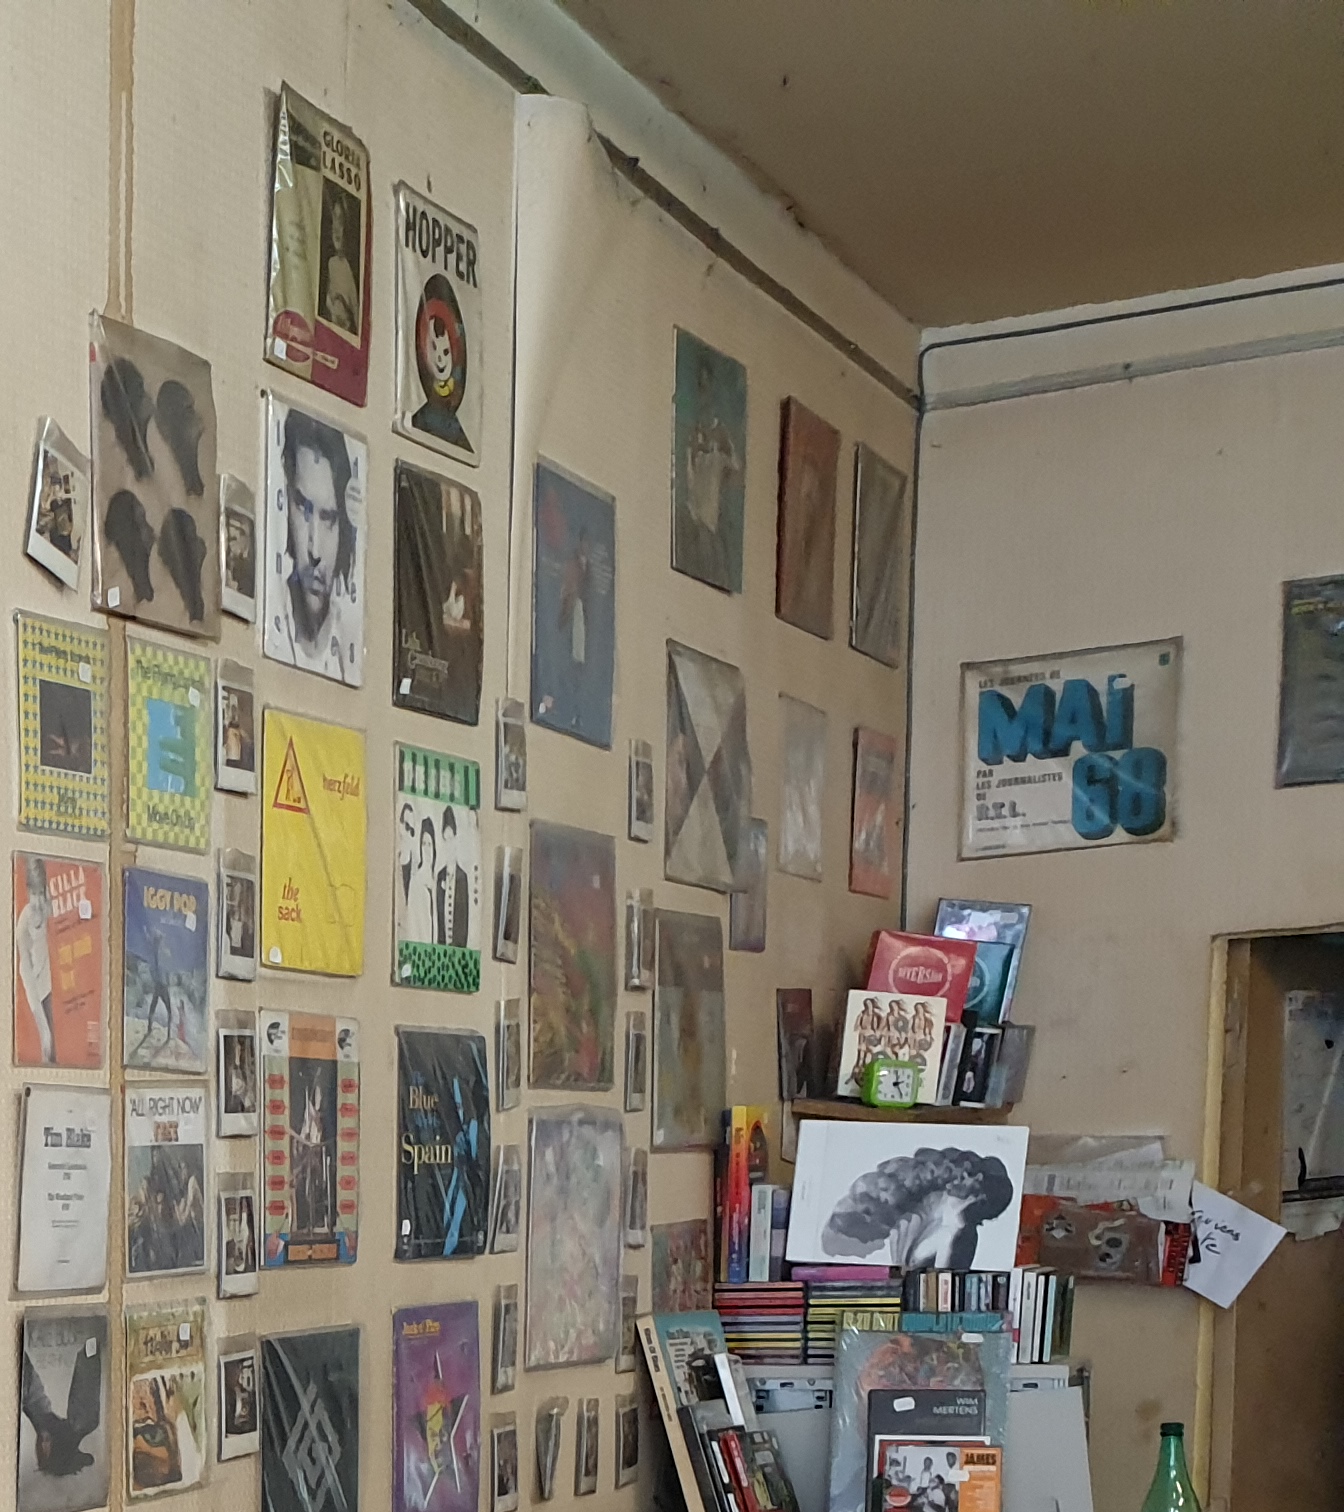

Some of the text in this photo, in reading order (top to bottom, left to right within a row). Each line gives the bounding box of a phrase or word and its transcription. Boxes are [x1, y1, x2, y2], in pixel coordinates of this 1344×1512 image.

[322, 150, 361, 192] LASSO
[323, 131, 361, 170] GLORIA
[404, 201, 478, 288] HOPPER
[978, 673, 1136, 765] MAI
[1072, 747, 1167, 840] 68
[49, 865, 85, 898] CILLA
[278, 904, 303, 923] sack
[401, 1131, 452, 1175] Spain
[964, 1453, 997, 1465] JAMES
